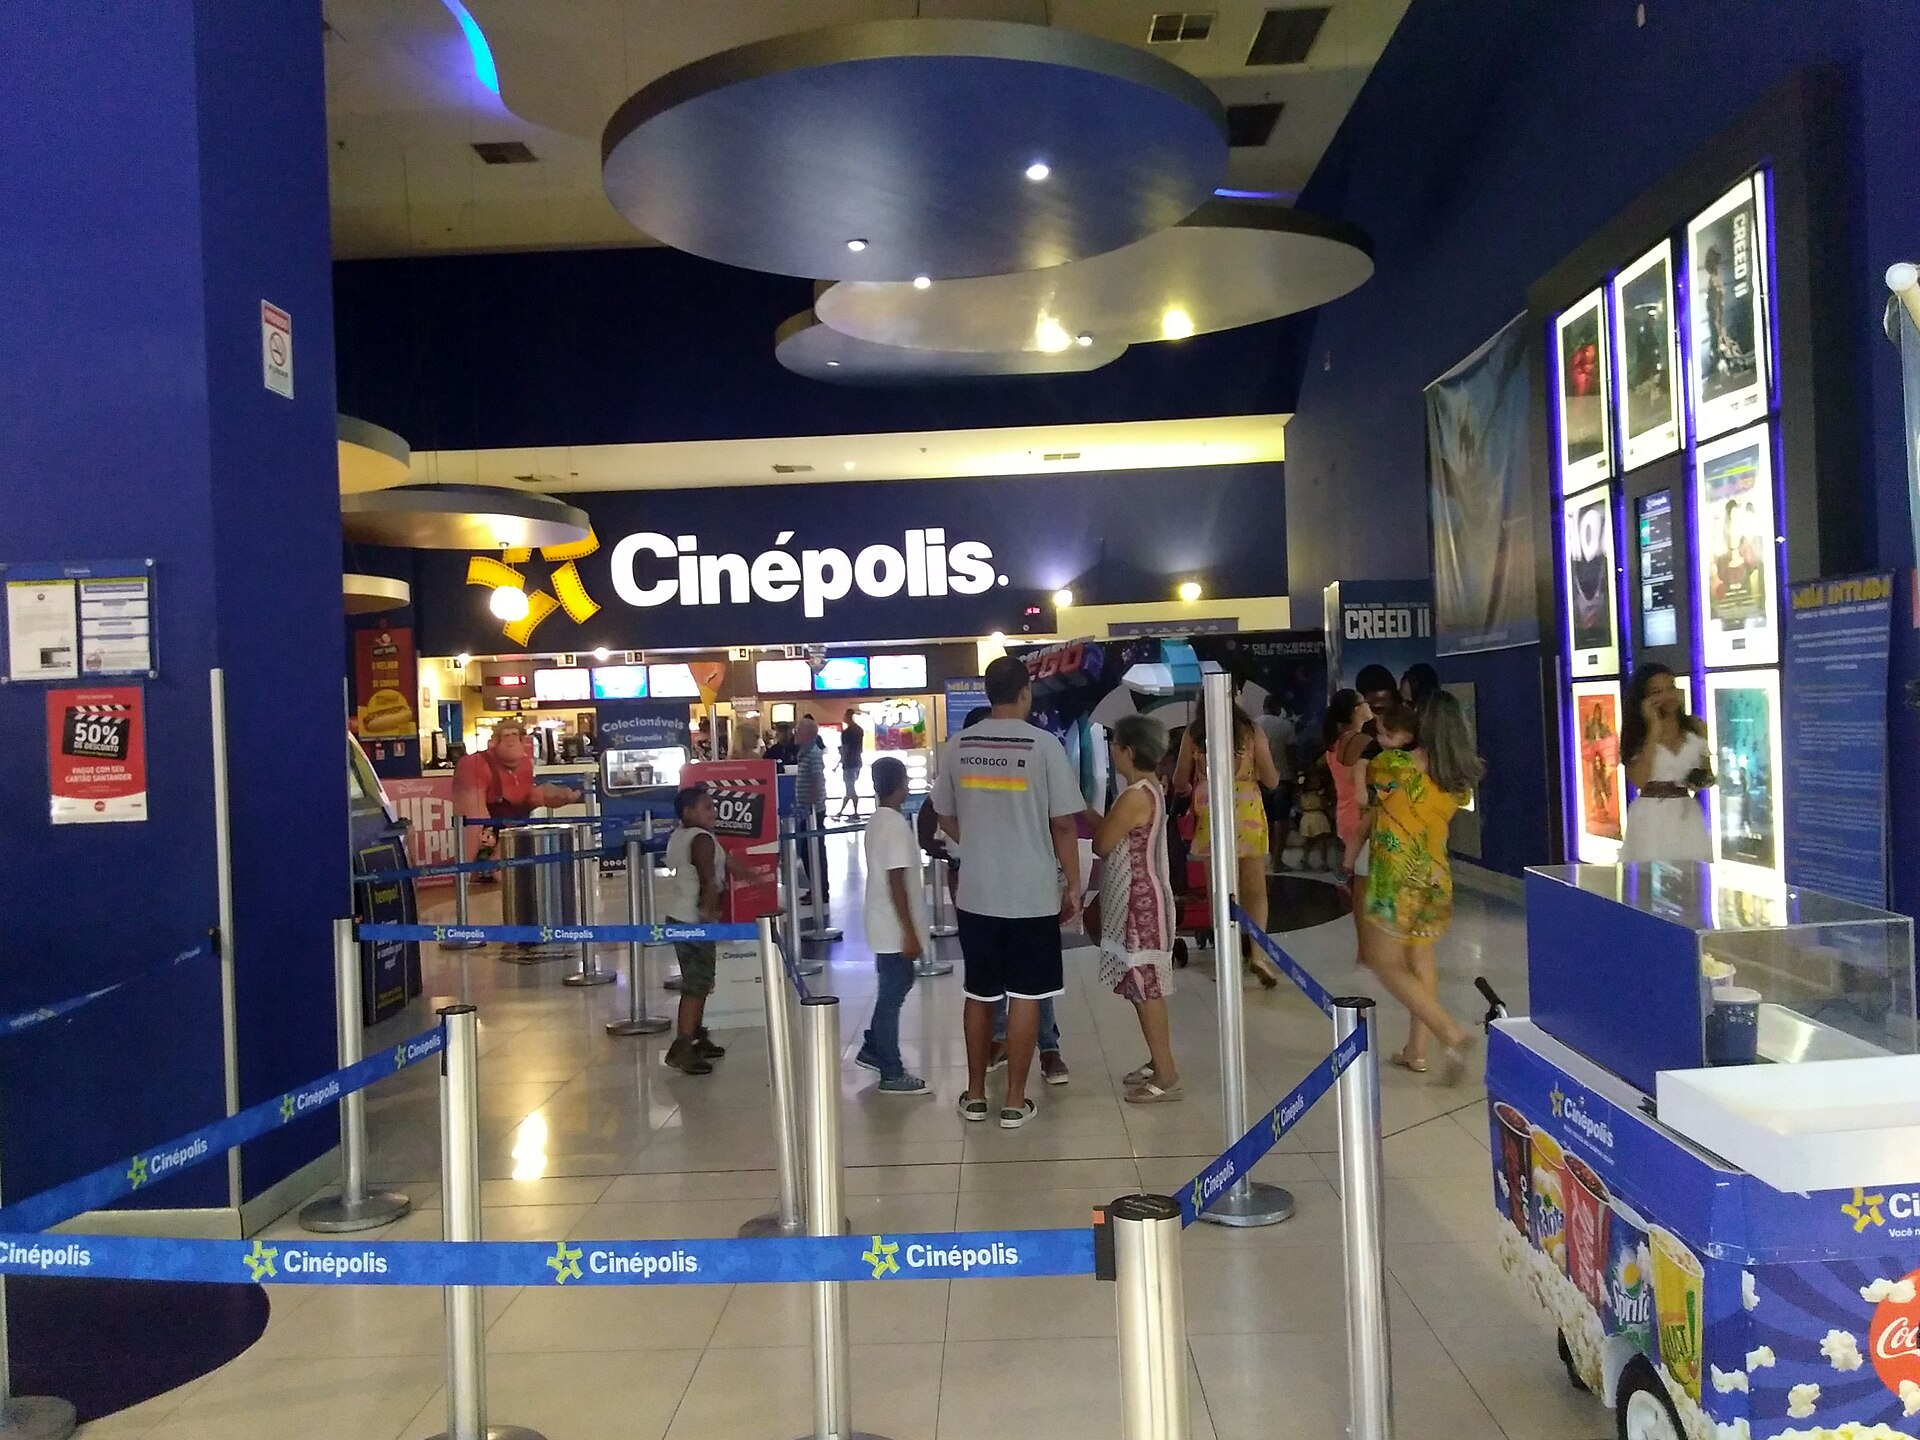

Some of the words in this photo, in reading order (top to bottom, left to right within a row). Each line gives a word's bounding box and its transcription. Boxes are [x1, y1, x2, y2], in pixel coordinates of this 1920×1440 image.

[1733, 212, 1748, 280] CREED
[1344, 609, 1412, 640] CREED
[1417, 608, 1431, 637] II
[1269, 641, 1325, 649] FEVEREIR
[75, 723, 119, 745] 50%
[601, 717, 684, 732] Colecionáveis
[84, 742, 119, 752] DESCONTO
[960, 757, 1008, 766] NICOBOCO
[447, 928, 485, 940] Cinépolis
[407, 1034, 441, 1059] Cinépolis
[297, 1080, 340, 1110] Cinépolis
[1564, 1097, 1614, 1147] Cinépolis
[151, 1138, 208, 1174] Cinépolis
[1203, 1158, 1235, 1198] Cinépolis
[1888, 1228, 1913, 1238] Você
[284, 1249, 389, 1278] Cinépolis
[588, 1249, 699, 1279] Cinépolis
[905, 1242, 1020, 1272] Cinépolis
[1612, 1279, 1651, 1326] Sprite
